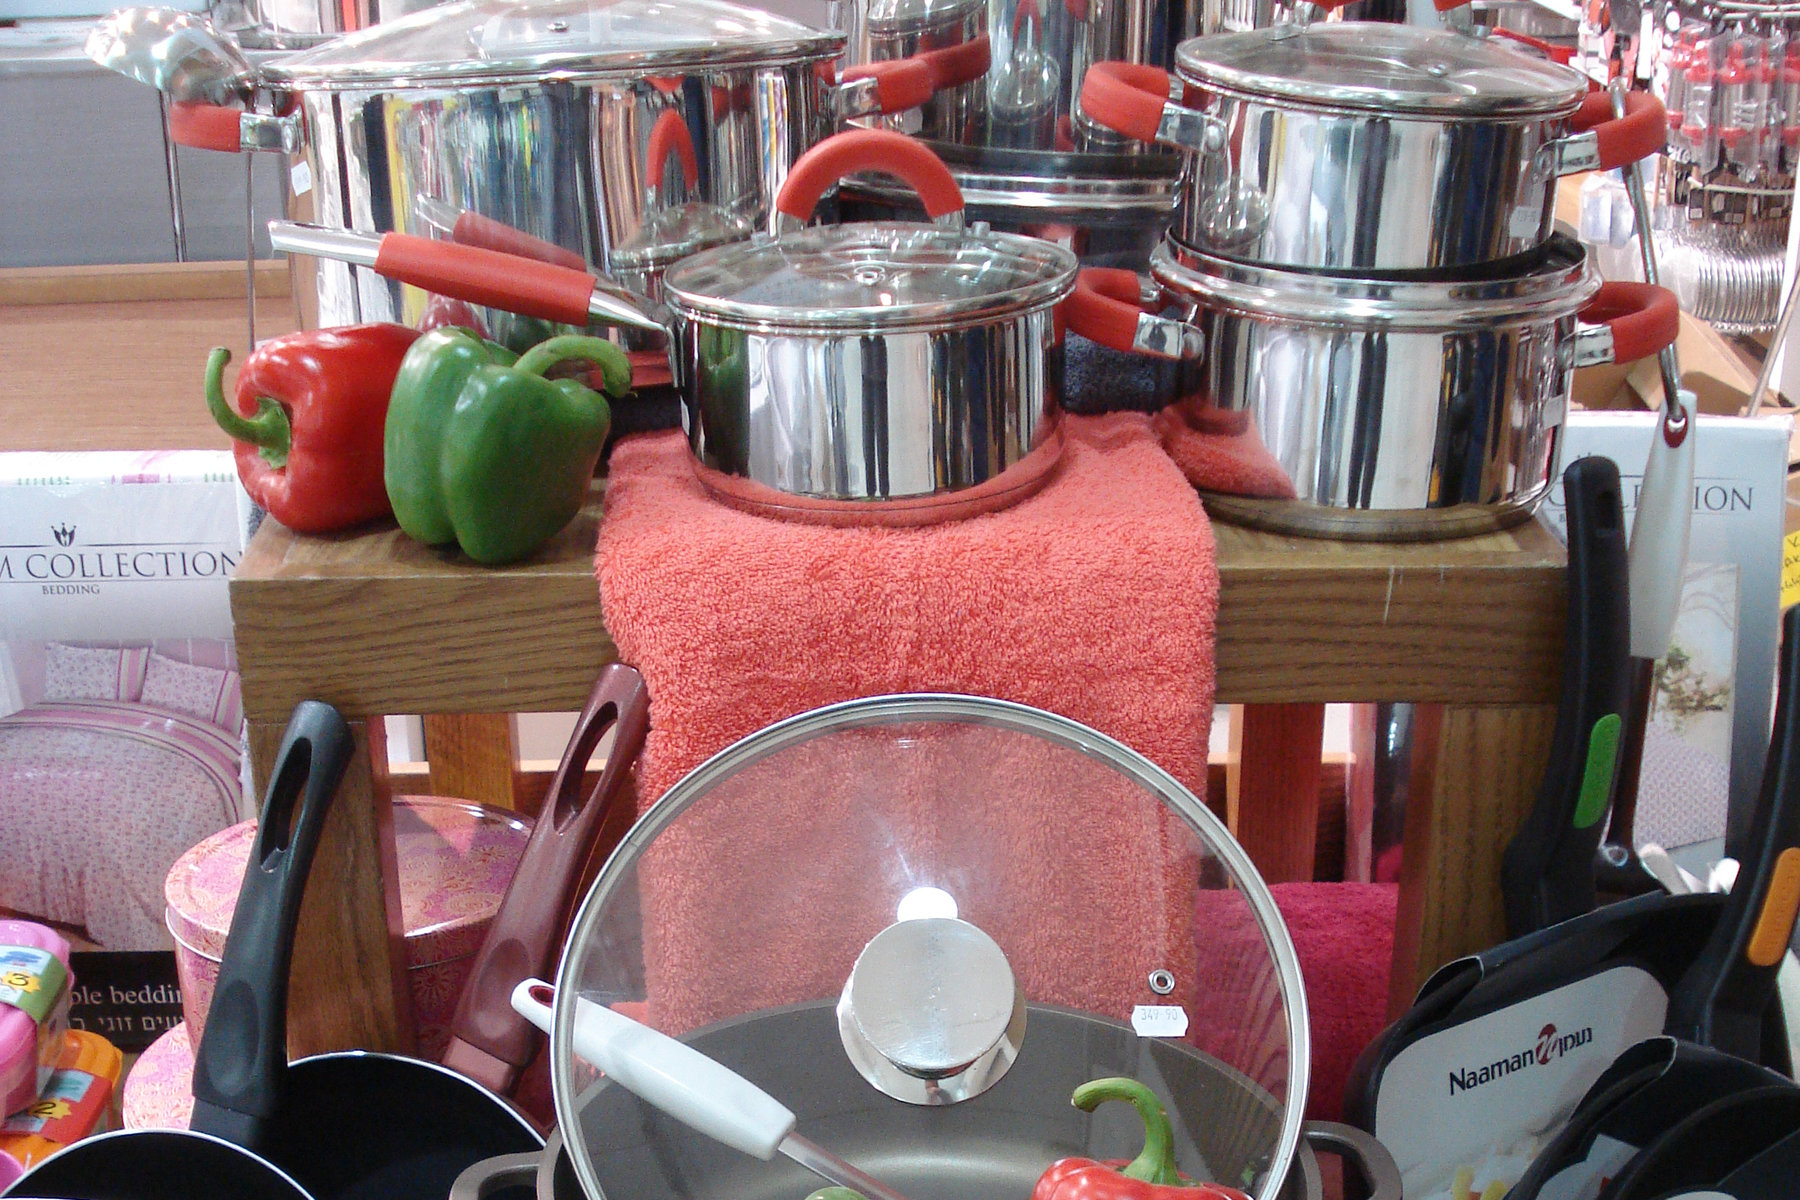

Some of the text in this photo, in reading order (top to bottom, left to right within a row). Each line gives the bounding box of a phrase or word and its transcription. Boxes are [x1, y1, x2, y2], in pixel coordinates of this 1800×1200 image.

[26, 551, 242, 579] COLLECTION
[42, 584, 100, 596] BEDDING
[1558, 1027, 1593, 1057] נעמן
[1449, 1049, 1535, 1096] Naaman
